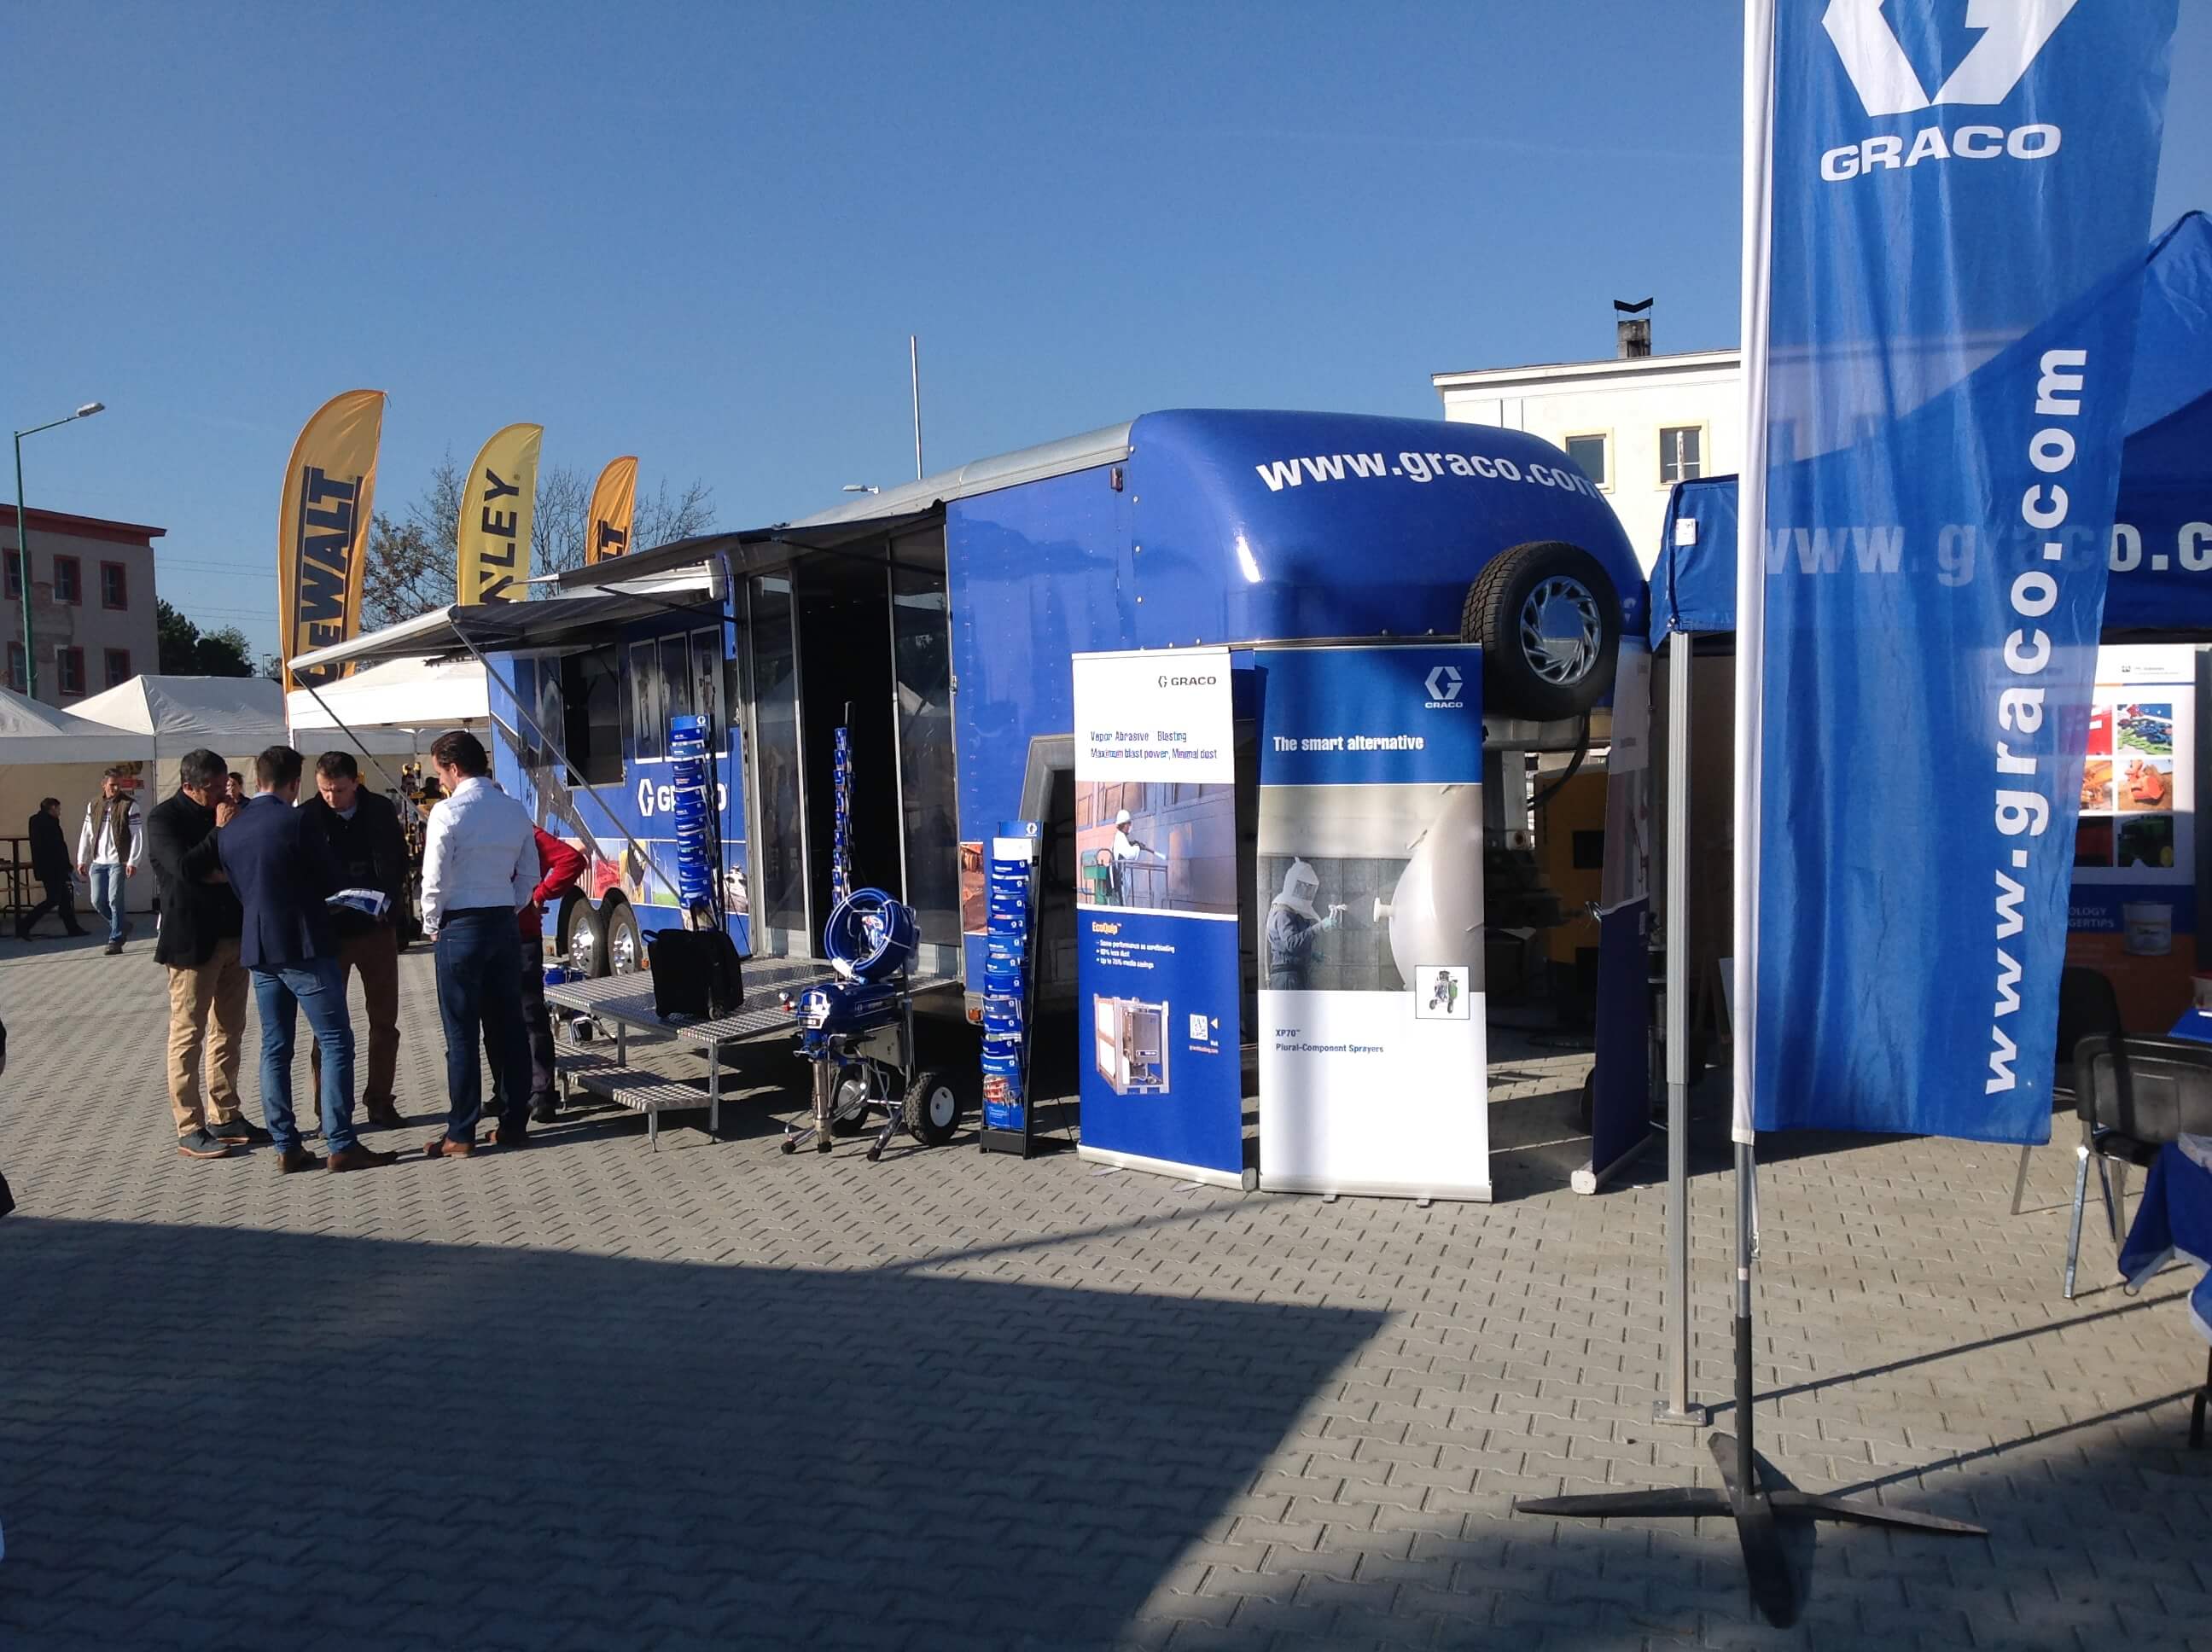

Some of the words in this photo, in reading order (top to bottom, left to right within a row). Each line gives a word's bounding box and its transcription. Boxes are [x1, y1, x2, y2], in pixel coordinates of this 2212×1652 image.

[1820, 125, 2062, 182] GRACO
[1255, 451, 1606, 503] www.graco.com
[1170, 676, 1217, 686] GRACO
[1984, 349, 2087, 1096] www.graco.com
[1115, 730, 1150, 742] Abrasive
[1272, 736, 1297, 752] The
[1301, 736, 1344, 751] smart
[1347, 735, 1424, 751] alternative
[1125, 747, 1143, 759] blast
